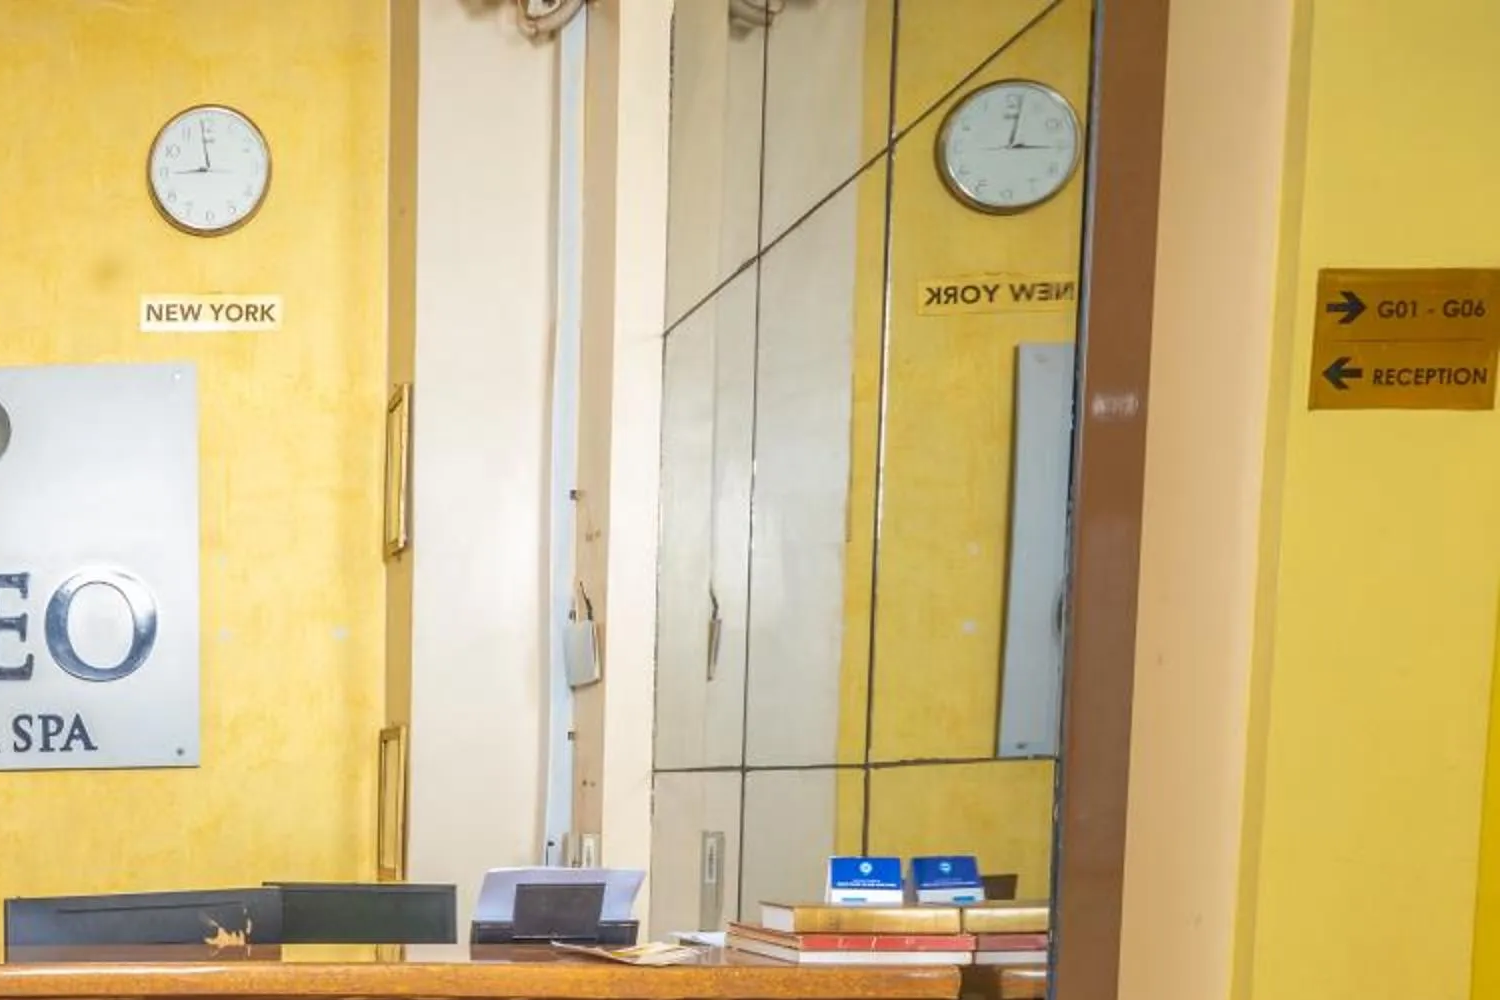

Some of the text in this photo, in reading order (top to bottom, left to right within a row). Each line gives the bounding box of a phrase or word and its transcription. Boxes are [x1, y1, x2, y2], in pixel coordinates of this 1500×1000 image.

[146, 303, 276, 322] NEW YORK
[1377, 300, 1417, 319] G01
[1443, 299, 1485, 318] G06
[1372, 367, 1487, 386] RECEPTION
[12, 713, 98, 753] SPA
